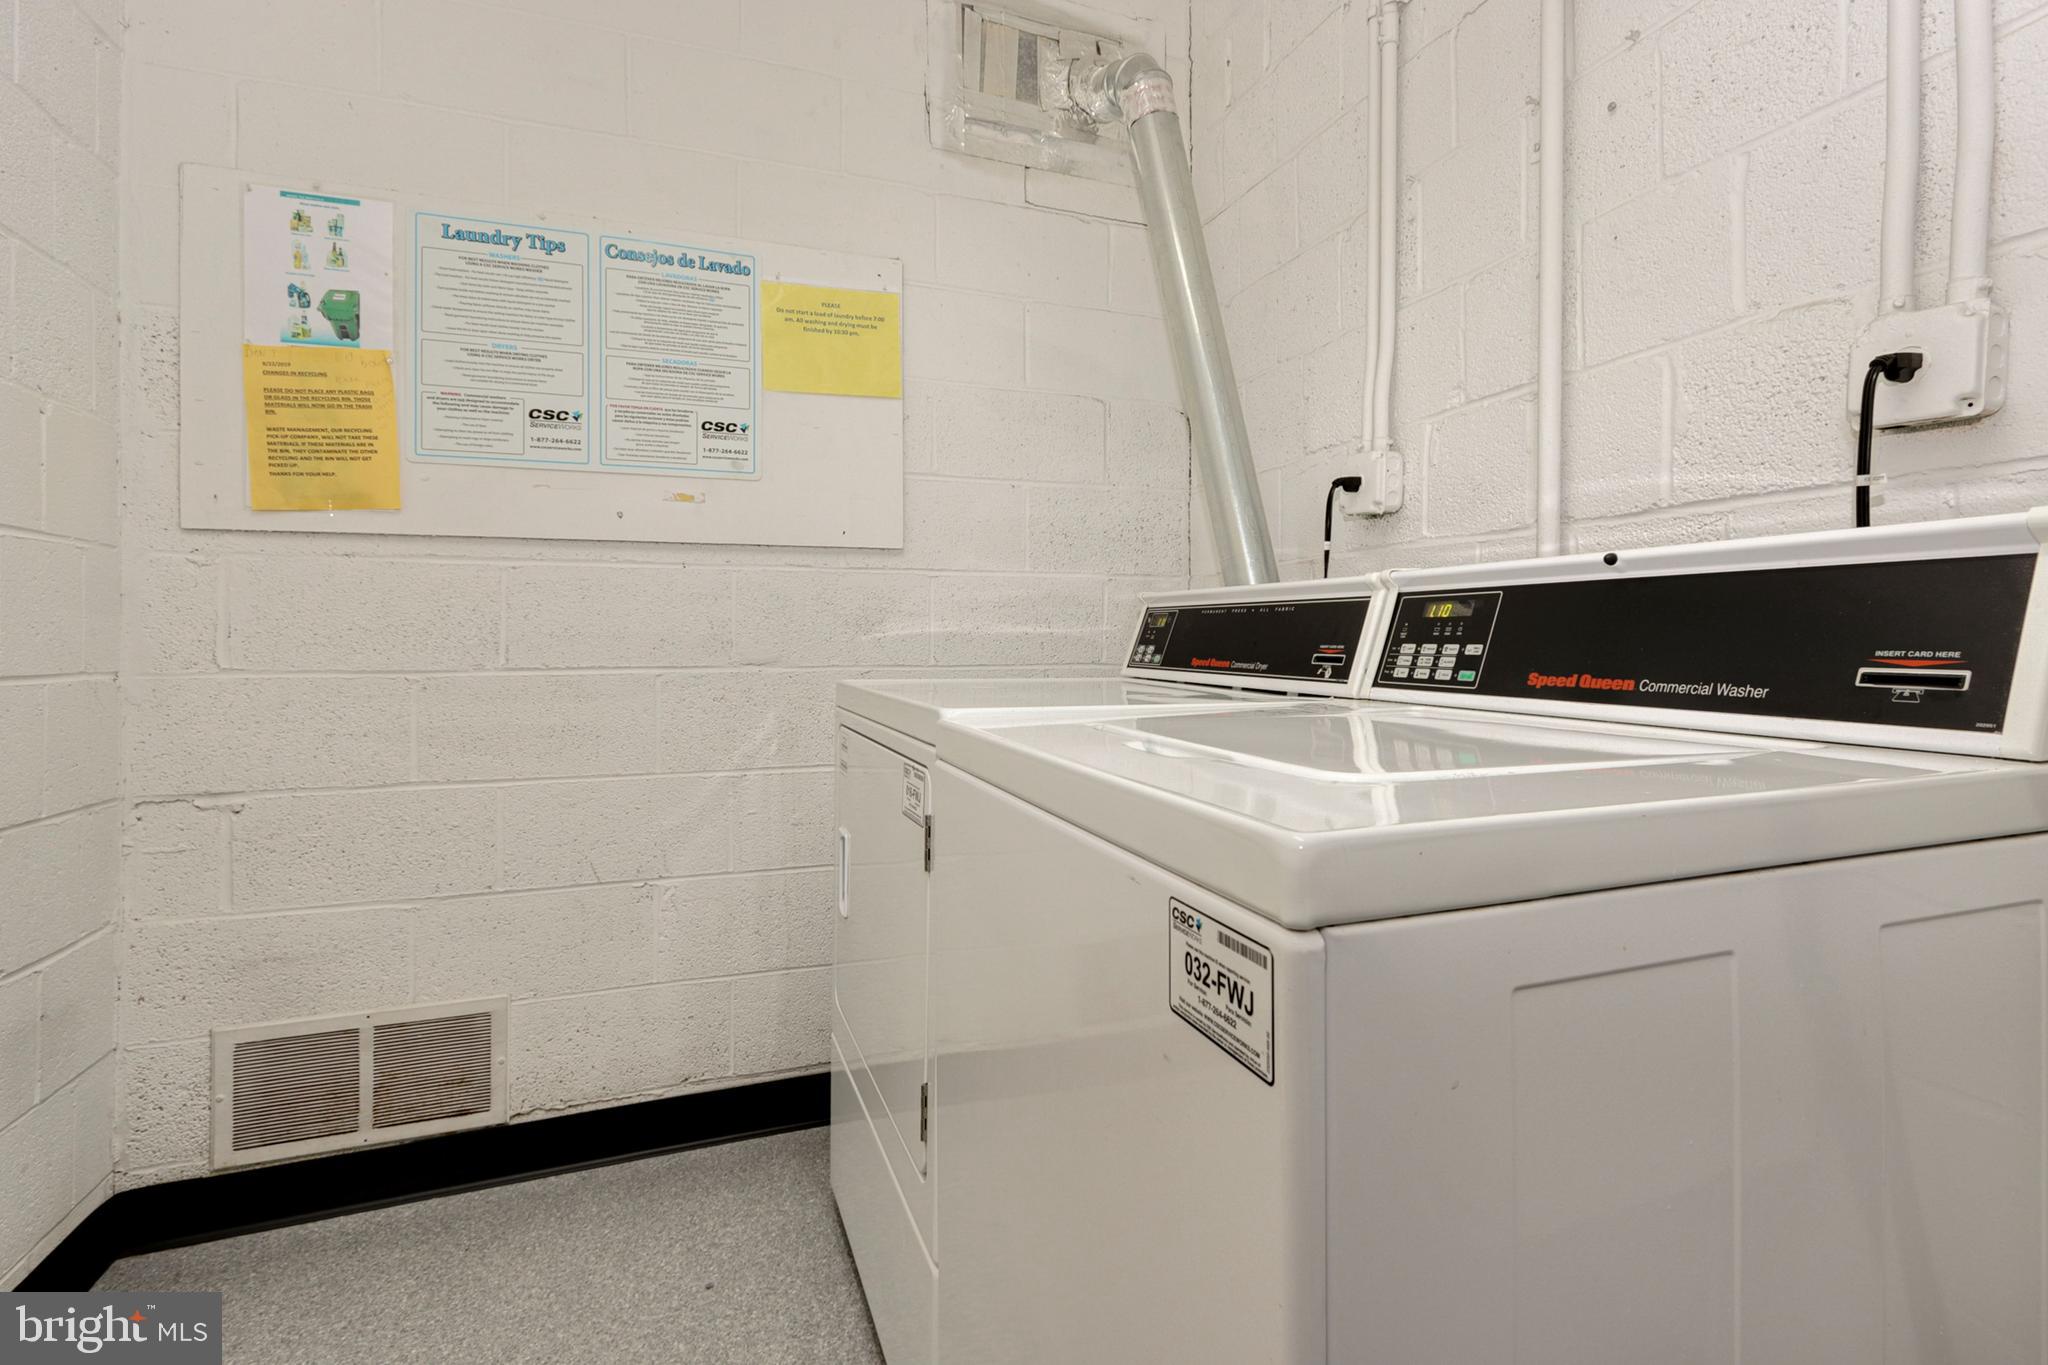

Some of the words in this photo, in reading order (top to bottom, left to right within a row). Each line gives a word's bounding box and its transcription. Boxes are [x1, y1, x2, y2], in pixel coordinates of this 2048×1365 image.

[441, 223, 522, 251] Laundry
[526, 233, 566, 256] Tips
[605, 244, 674, 268] Consejos
[677, 253, 695, 268] de
[698, 256, 750, 276] Lavado
[529, 408, 570, 421] CSC
[701, 420, 738, 433] CSC
[530, 436, 582, 445] 1-877-264-6622
[703, 447, 748, 455] 1-877-264-6622
[1191, 657, 1210, 667] Speed
[1211, 658, 1230, 667] Queen
[1231, 660, 1255, 669] Commercial
[1255, 662, 1268, 671] Dryer
[1527, 672, 1578, 688] Speed
[1579, 674, 1635, 691] Queen
[1639, 679, 1714, 696] Commercial
[1716, 683, 1770, 699] Washer
[1172, 907, 1194, 928] CSC
[1185, 952, 1254, 1016] 032-FWJ
